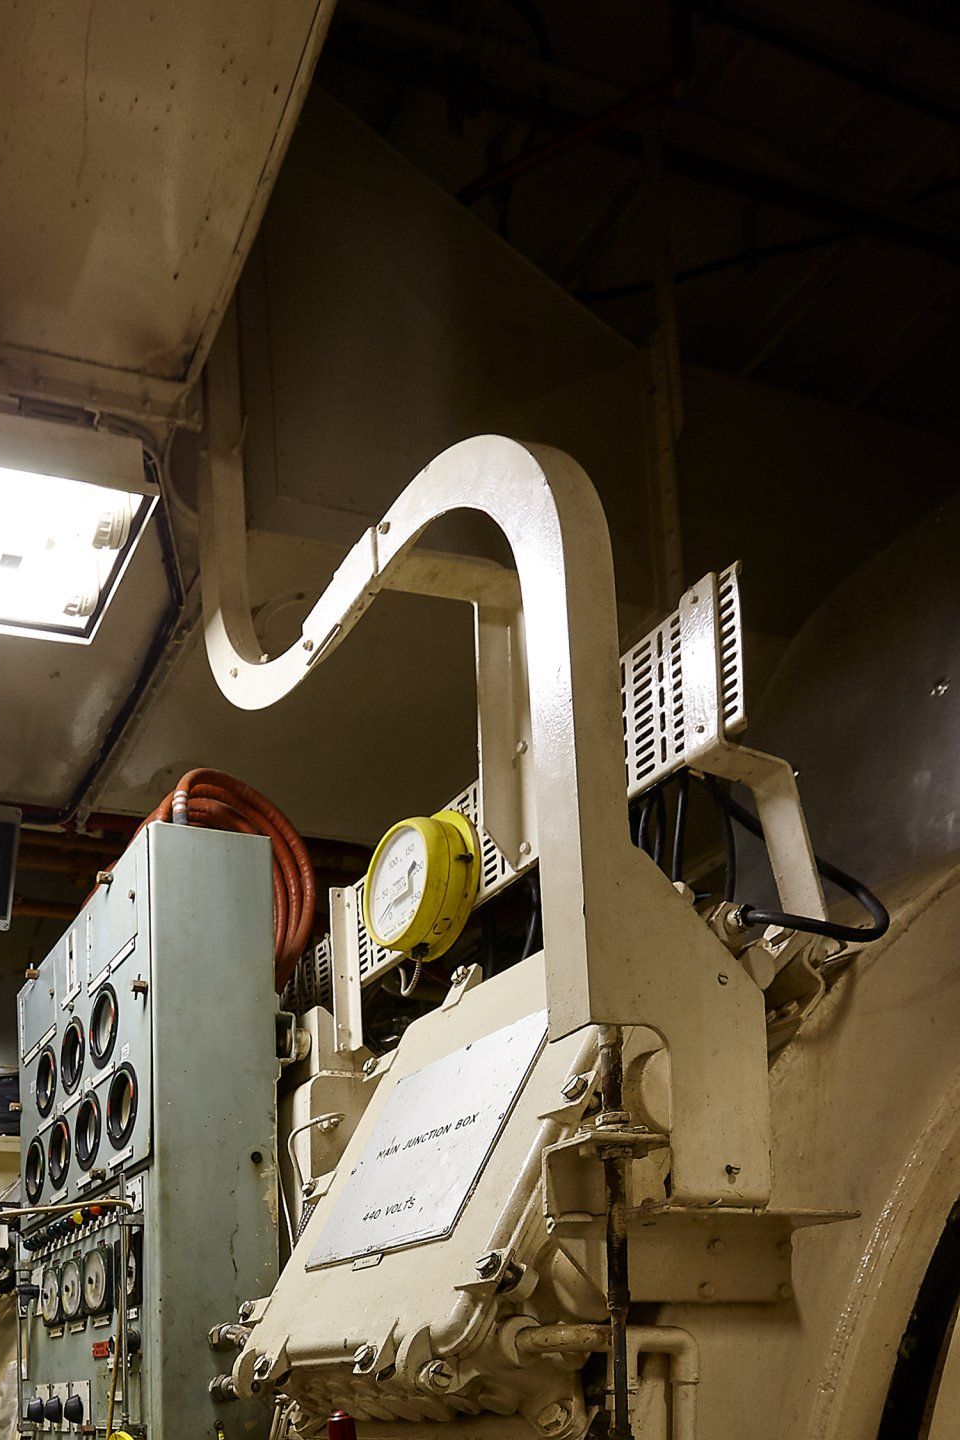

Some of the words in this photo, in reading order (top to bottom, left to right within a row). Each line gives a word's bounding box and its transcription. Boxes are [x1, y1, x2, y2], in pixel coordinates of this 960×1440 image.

[376, 1143, 401, 1160] MAIN
[402, 1123, 452, 1150] JUNCTION
[454, 1112, 480, 1131] BOX
[362, 1209, 381, 1223] 440
[385, 1197, 417, 1216] VOLTS
